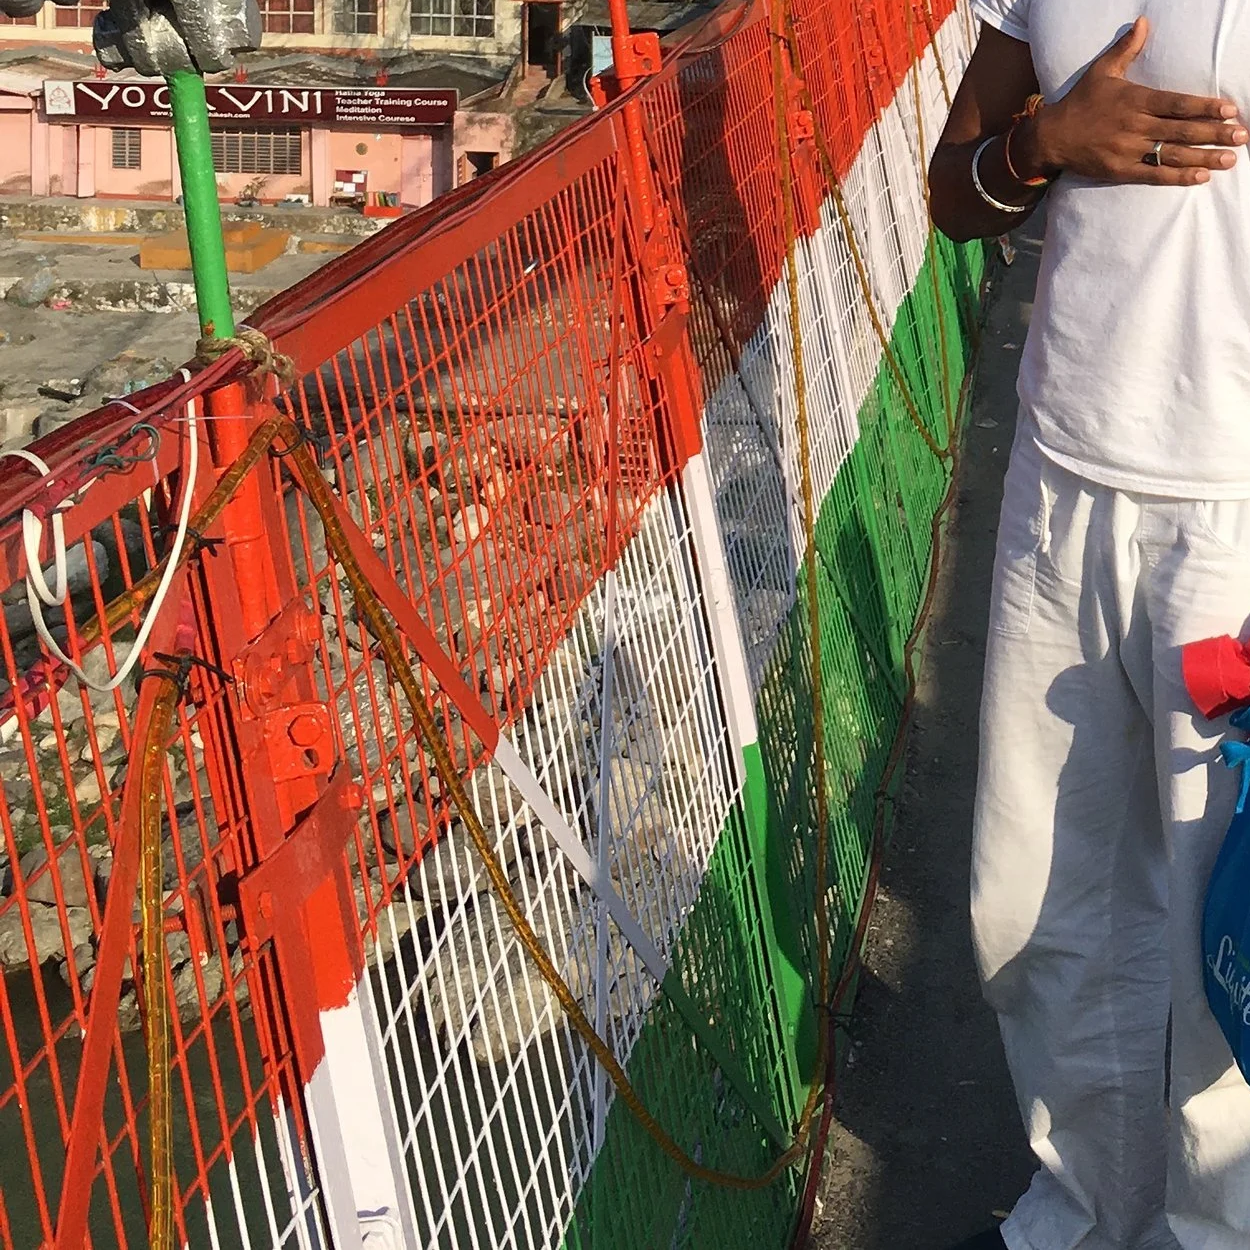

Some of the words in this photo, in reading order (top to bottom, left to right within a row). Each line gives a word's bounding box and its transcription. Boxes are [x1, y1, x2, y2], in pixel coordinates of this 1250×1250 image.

[218, 87, 322, 114] VINI
[335, 97, 372, 105] Teacher
[374, 98, 412, 107] Training
[414, 98, 448, 106] Course
